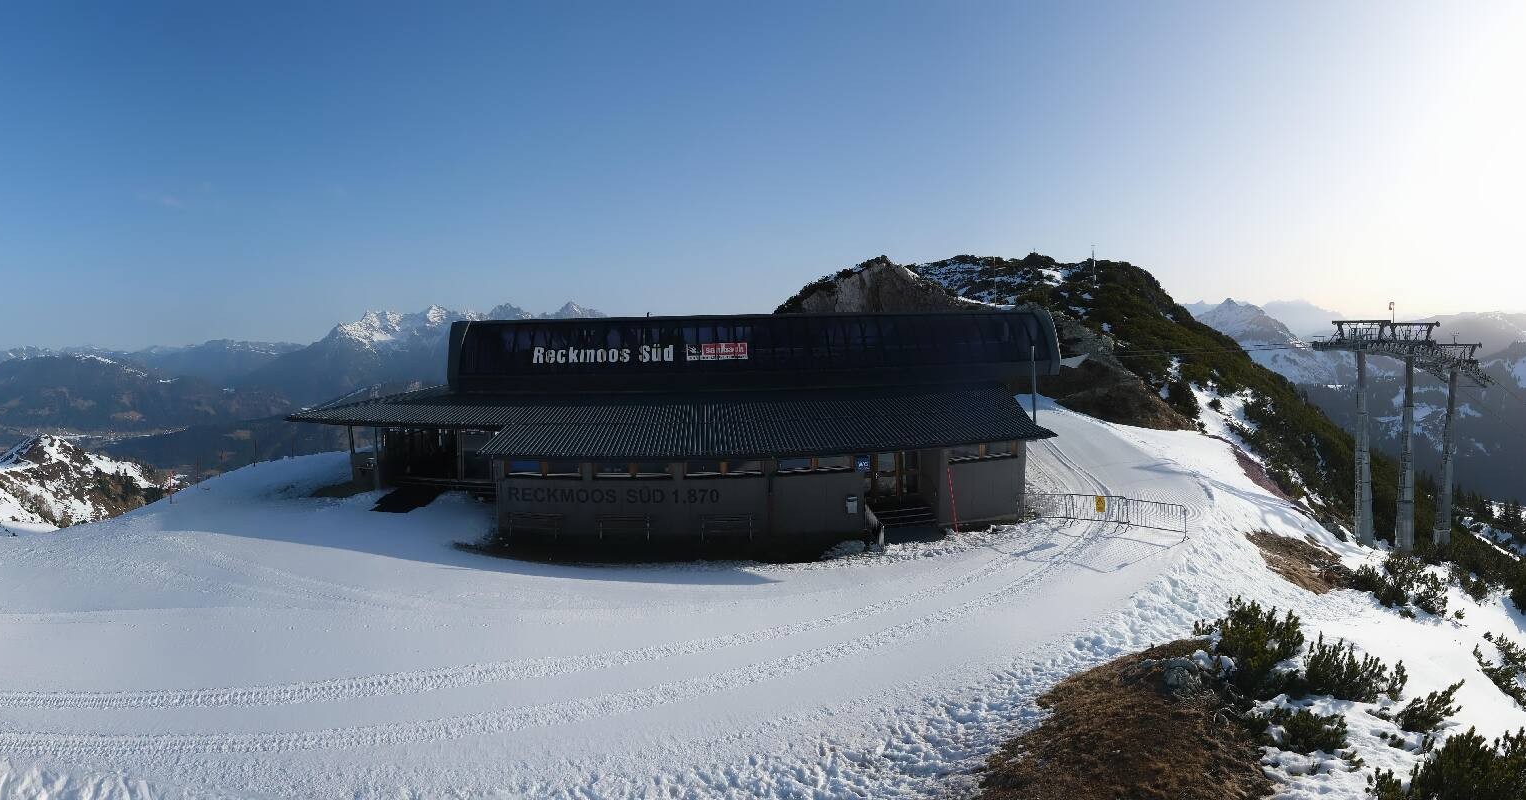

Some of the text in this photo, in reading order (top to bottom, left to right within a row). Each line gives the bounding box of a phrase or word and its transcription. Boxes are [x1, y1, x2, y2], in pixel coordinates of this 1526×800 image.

[532, 344, 674, 363] Reckmoos Süd
[508, 486, 720, 503] RECKMOOS SÜD 1.870
